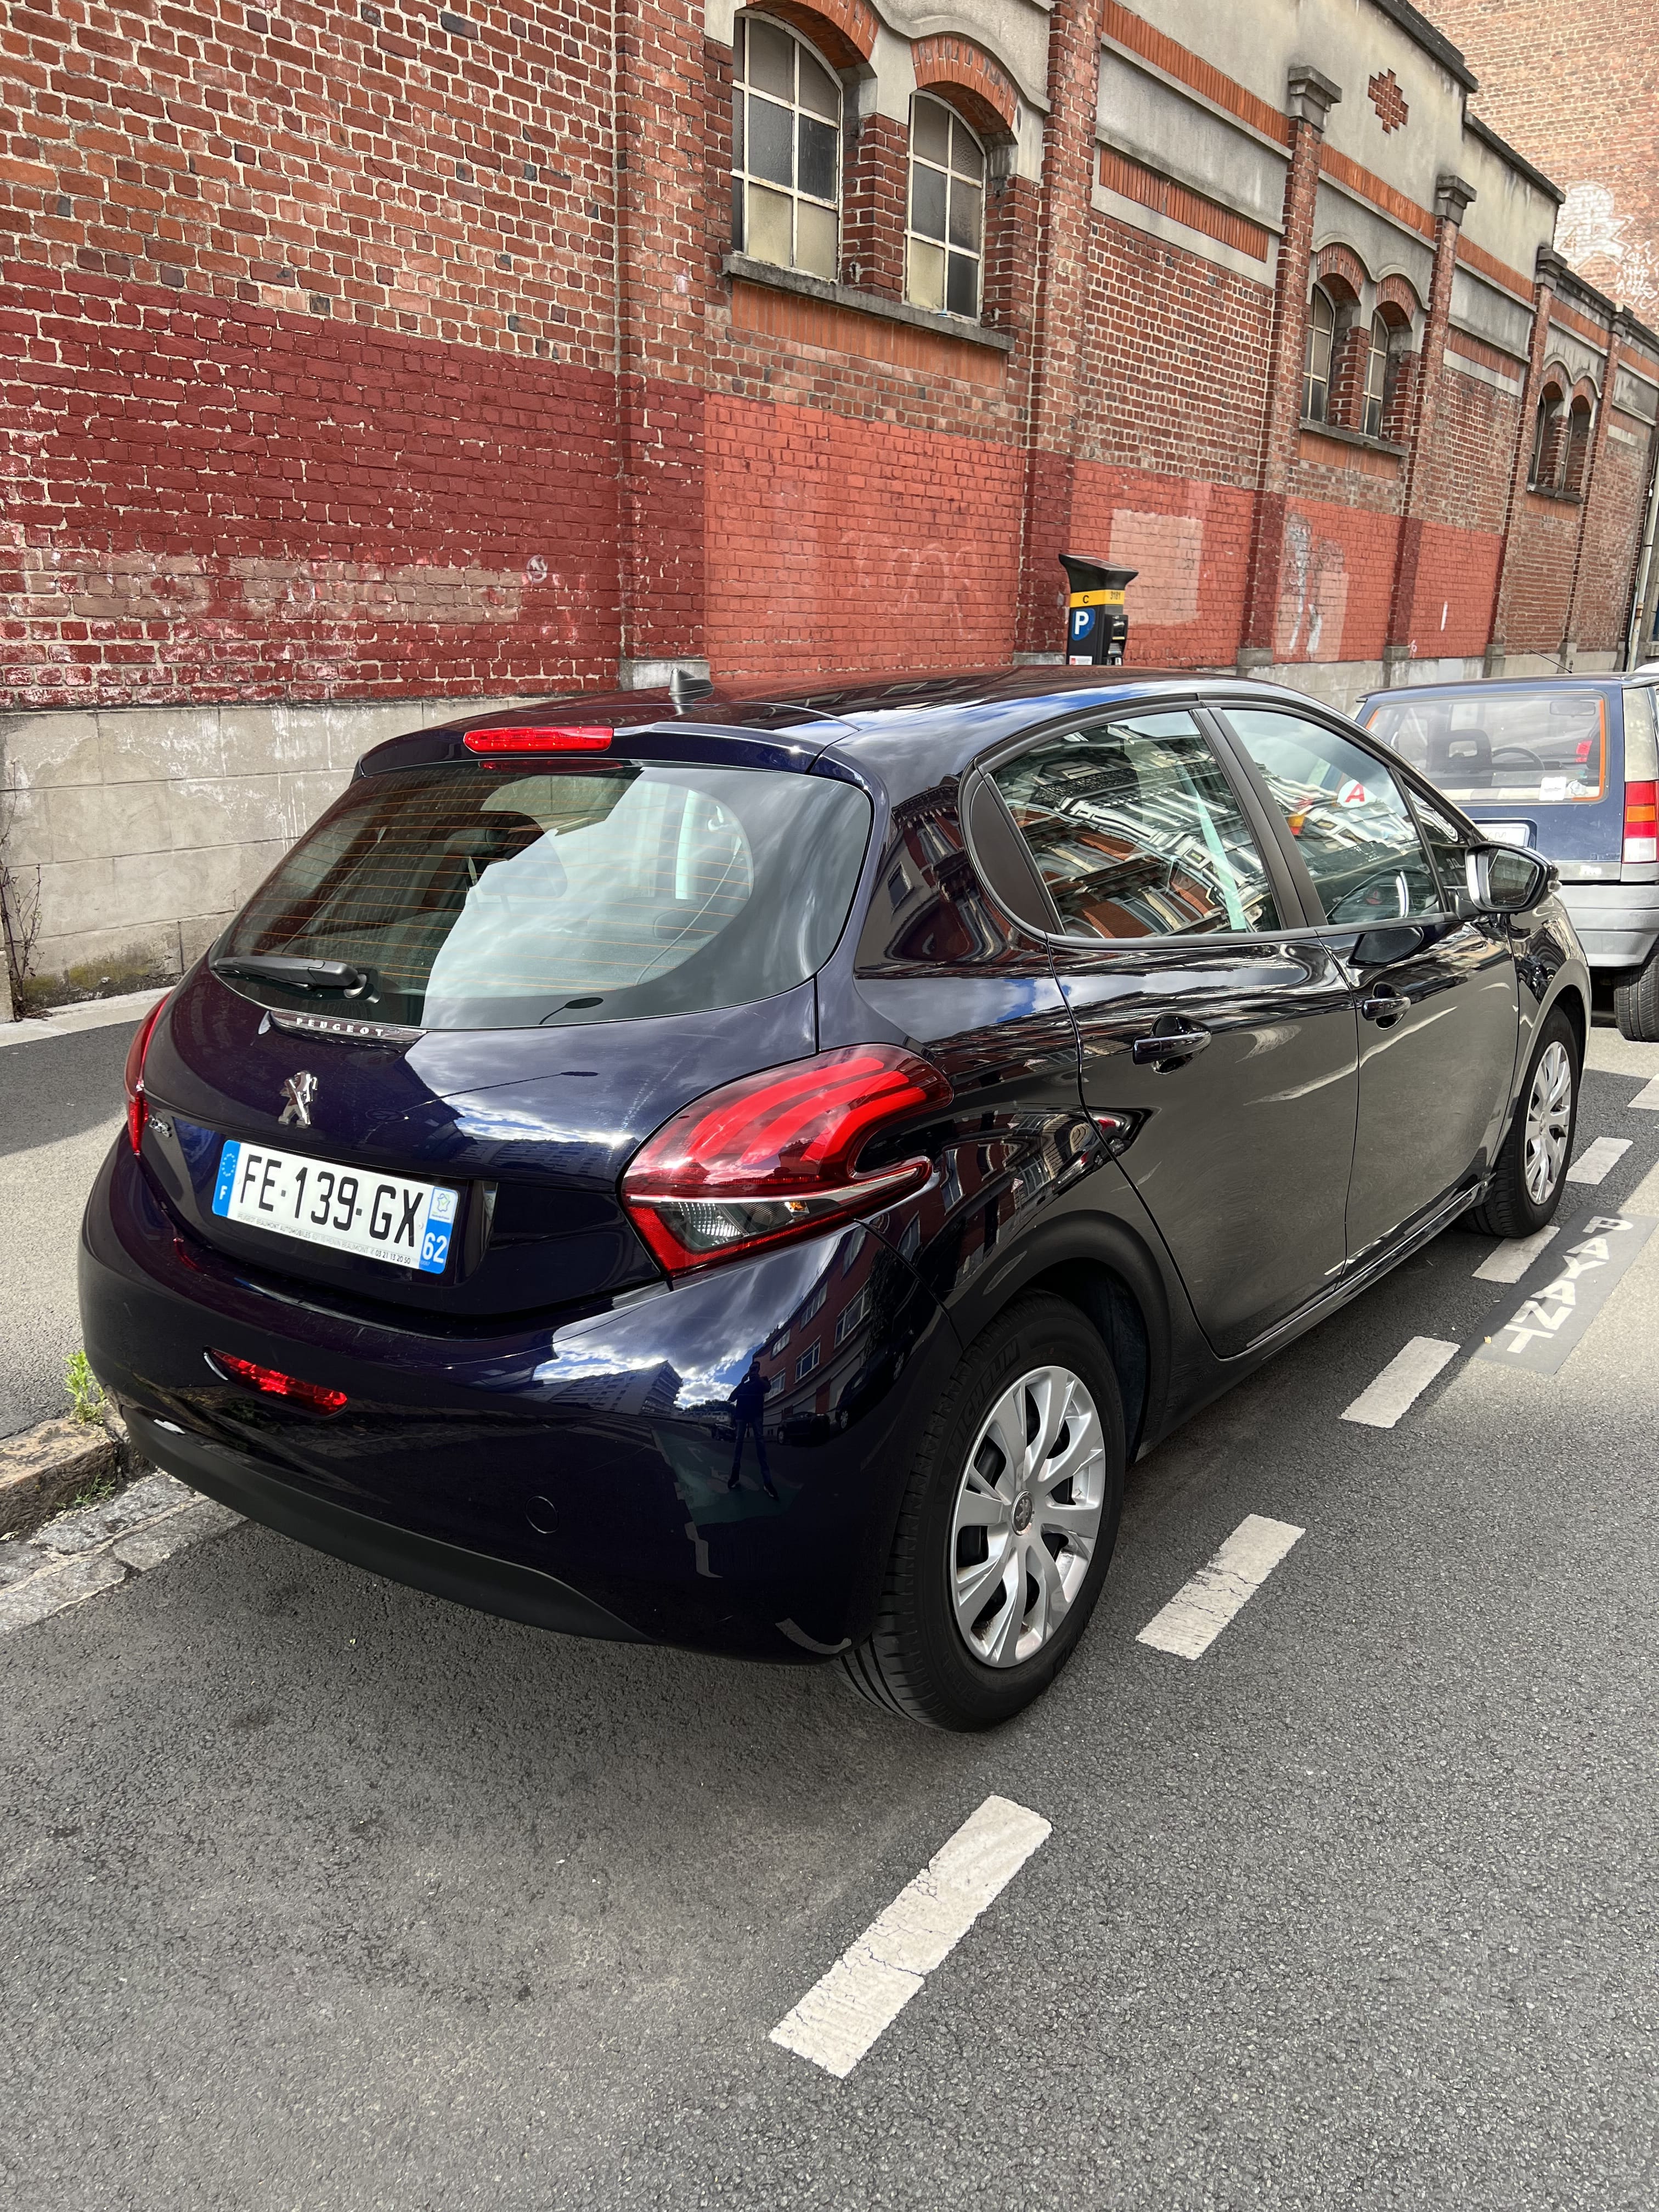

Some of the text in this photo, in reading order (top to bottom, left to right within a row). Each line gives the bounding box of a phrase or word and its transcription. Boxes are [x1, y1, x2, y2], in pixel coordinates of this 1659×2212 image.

[1082, 595, 1090, 604] C
[1074, 611, 1090, 635] P
[1345, 783, 1365, 803] A
[296, 1017, 383, 1036] PEUGEOT
[219, 1185, 228, 1200] F
[280, 1224, 311, 1239] AUTOMOBILES
[422, 1232, 448, 1264] 62
[1504, 1215, 1634, 1353] PAYANT
[946, 1339, 1020, 1467] MICHELIN
